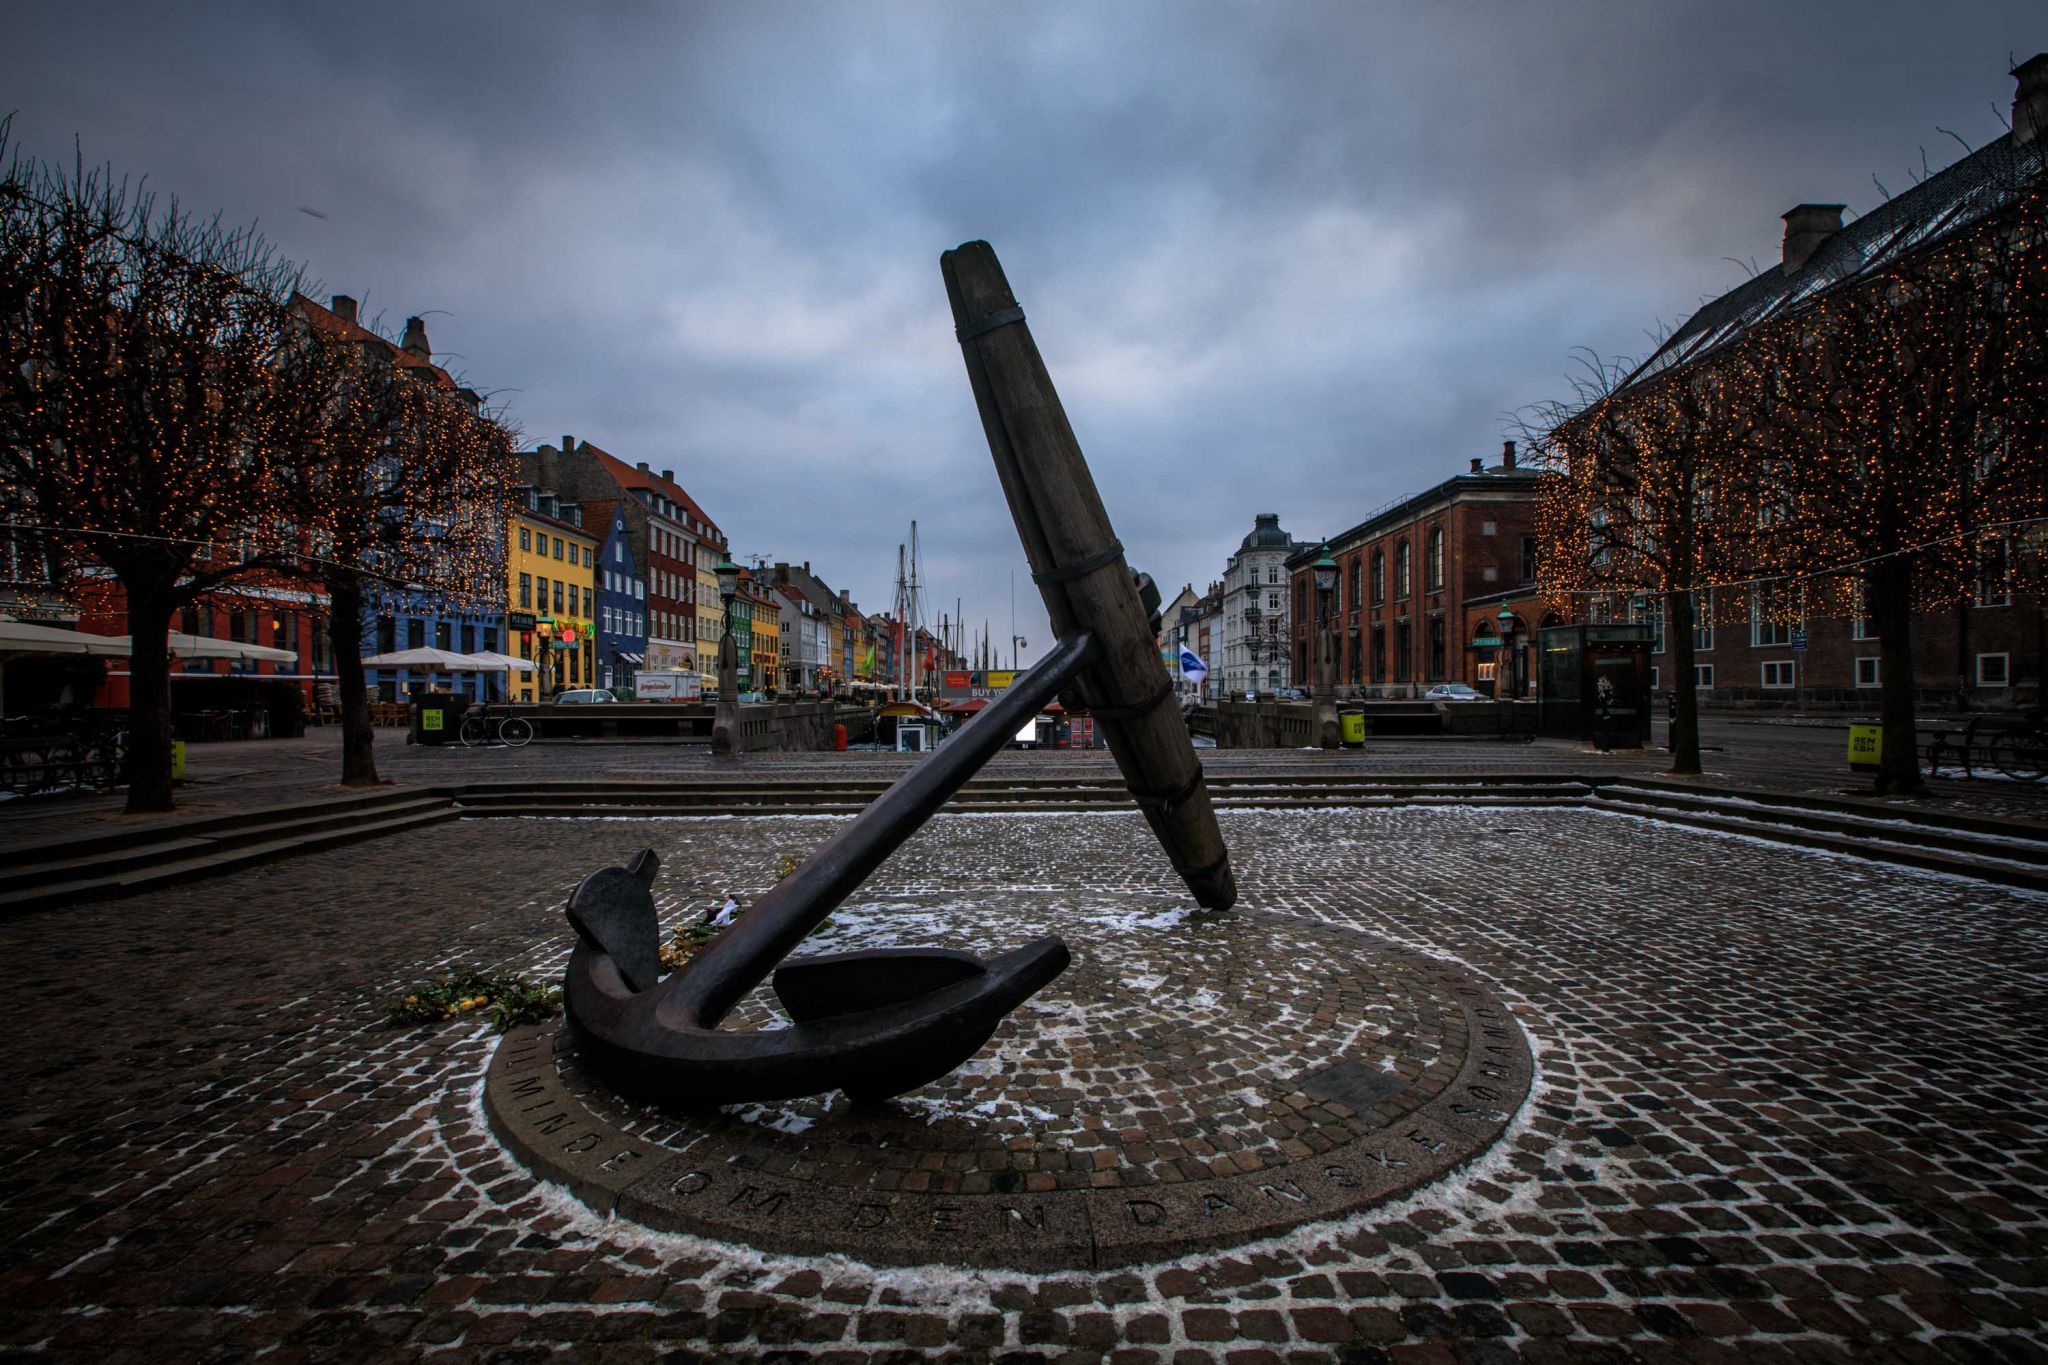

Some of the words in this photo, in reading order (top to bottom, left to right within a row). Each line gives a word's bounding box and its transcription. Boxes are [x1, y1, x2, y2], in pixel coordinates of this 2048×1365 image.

[971, 688, 991, 697] BUY
[1855, 736, 1875, 744] REN
[510, 1075, 642, 1173] MINDE
[670, 1171, 791, 1215] OM
[845, 1204, 1045, 1232] DEN
[1125, 1129, 1446, 1227] DANSKE
